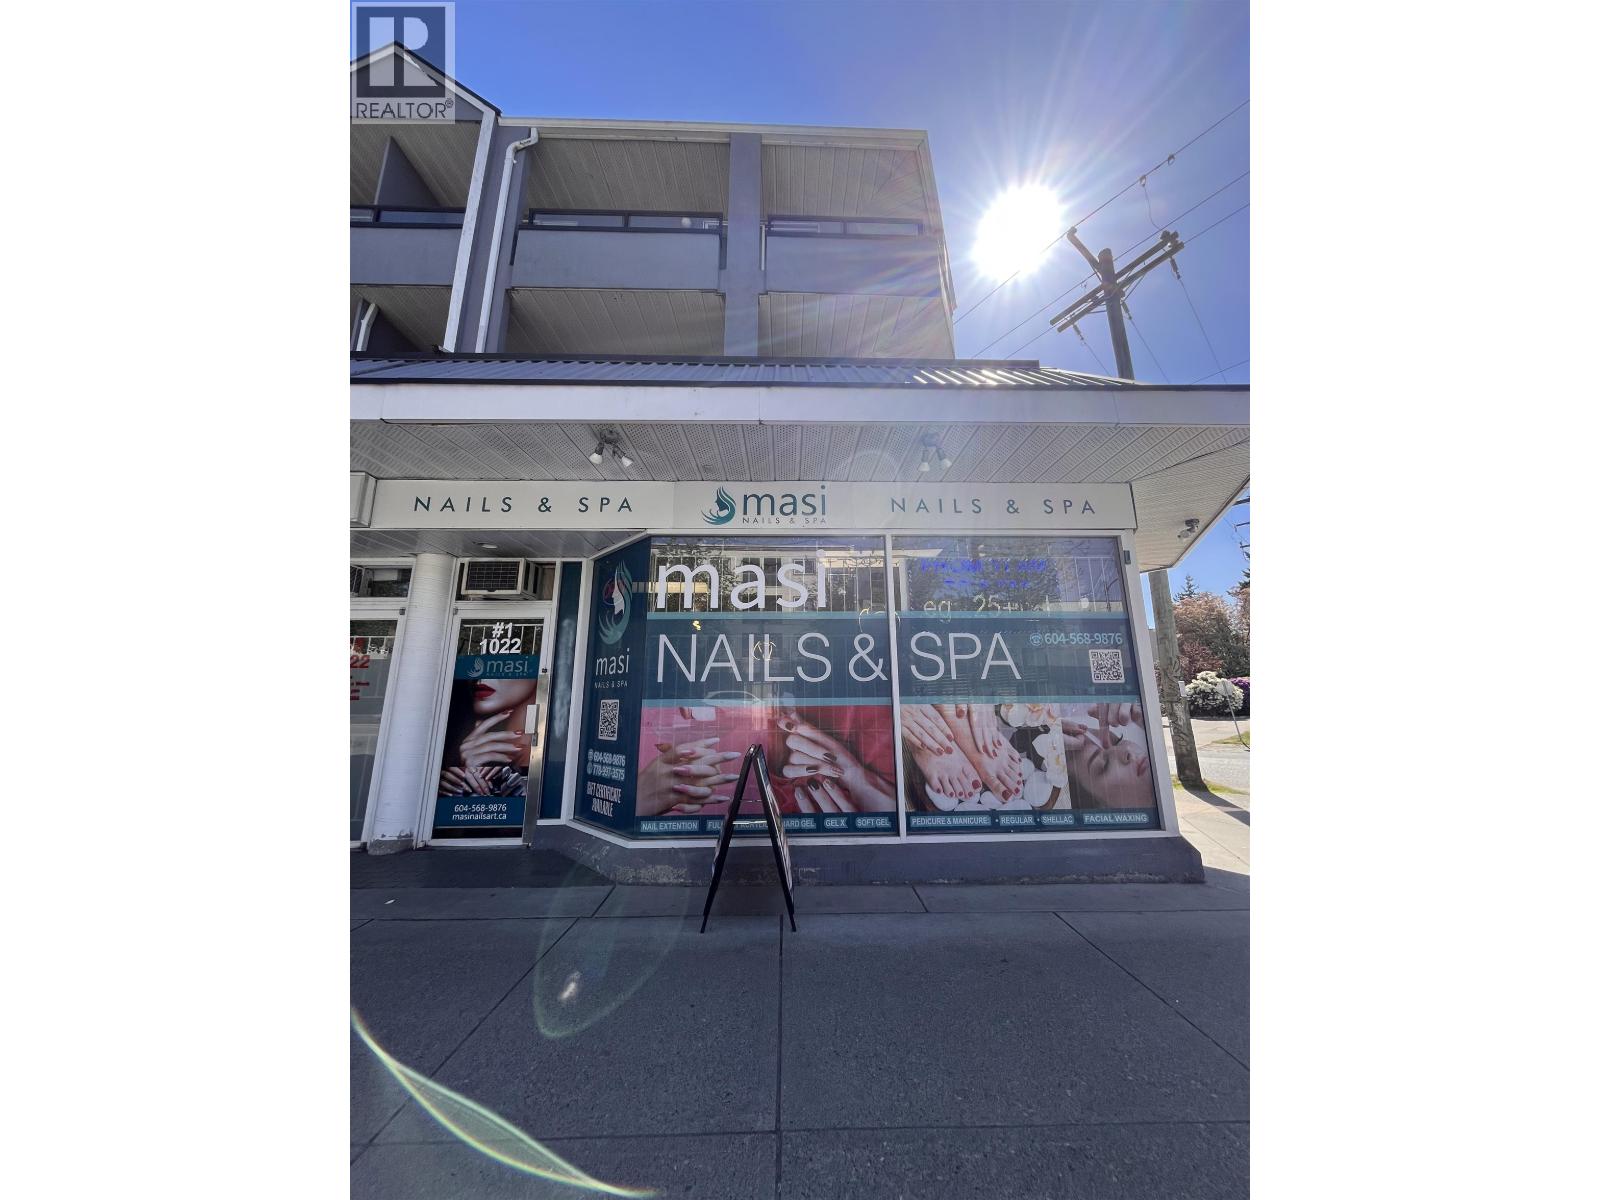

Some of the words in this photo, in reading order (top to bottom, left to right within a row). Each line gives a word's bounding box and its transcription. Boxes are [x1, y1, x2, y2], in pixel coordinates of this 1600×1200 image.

[414, 496, 512, 512] NAILS
[537, 496, 552, 512] &
[578, 496, 633, 512] SPA
[743, 485, 826, 516] masi
[891, 498, 982, 514] NAILS
[1006, 499, 1020, 514] &
[1043, 499, 1095, 514] SPA
[656, 549, 827, 610] masi
[491, 622, 513, 638] #1
[1044, 632, 1123, 645] 604-568-9876
[480, 638, 521, 655] 1022
[596, 647, 630, 676] masi
[657, 632, 832, 682] NAILS
[848, 633, 888, 682] &
[910, 631, 1022, 681] SPA
[486, 656, 529, 673] masi
[454, 803, 507, 813] 604-568-9876
[452, 812, 507, 821] masinailsart.ca
[912, 817, 945, 825] PEDICURE
[946, 817, 952, 825] &
[952, 817, 988, 825] MANICURE
[1001, 816, 1033, 824] REGULAR
[1042, 815, 1073, 823] SHELLAC
[1084, 815, 1112, 823] FACIAL
[1115, 814, 1148, 822] WAXING
[642, 823, 658, 831] NAIL
[659, 822, 698, 830] EXTENTION
[801, 819, 815, 827] GEL
[825, 819, 839, 827] GEL
[840, 819, 845, 827] X
[857, 818, 874, 827] SOFT
[875, 818, 889, 826] GEL
